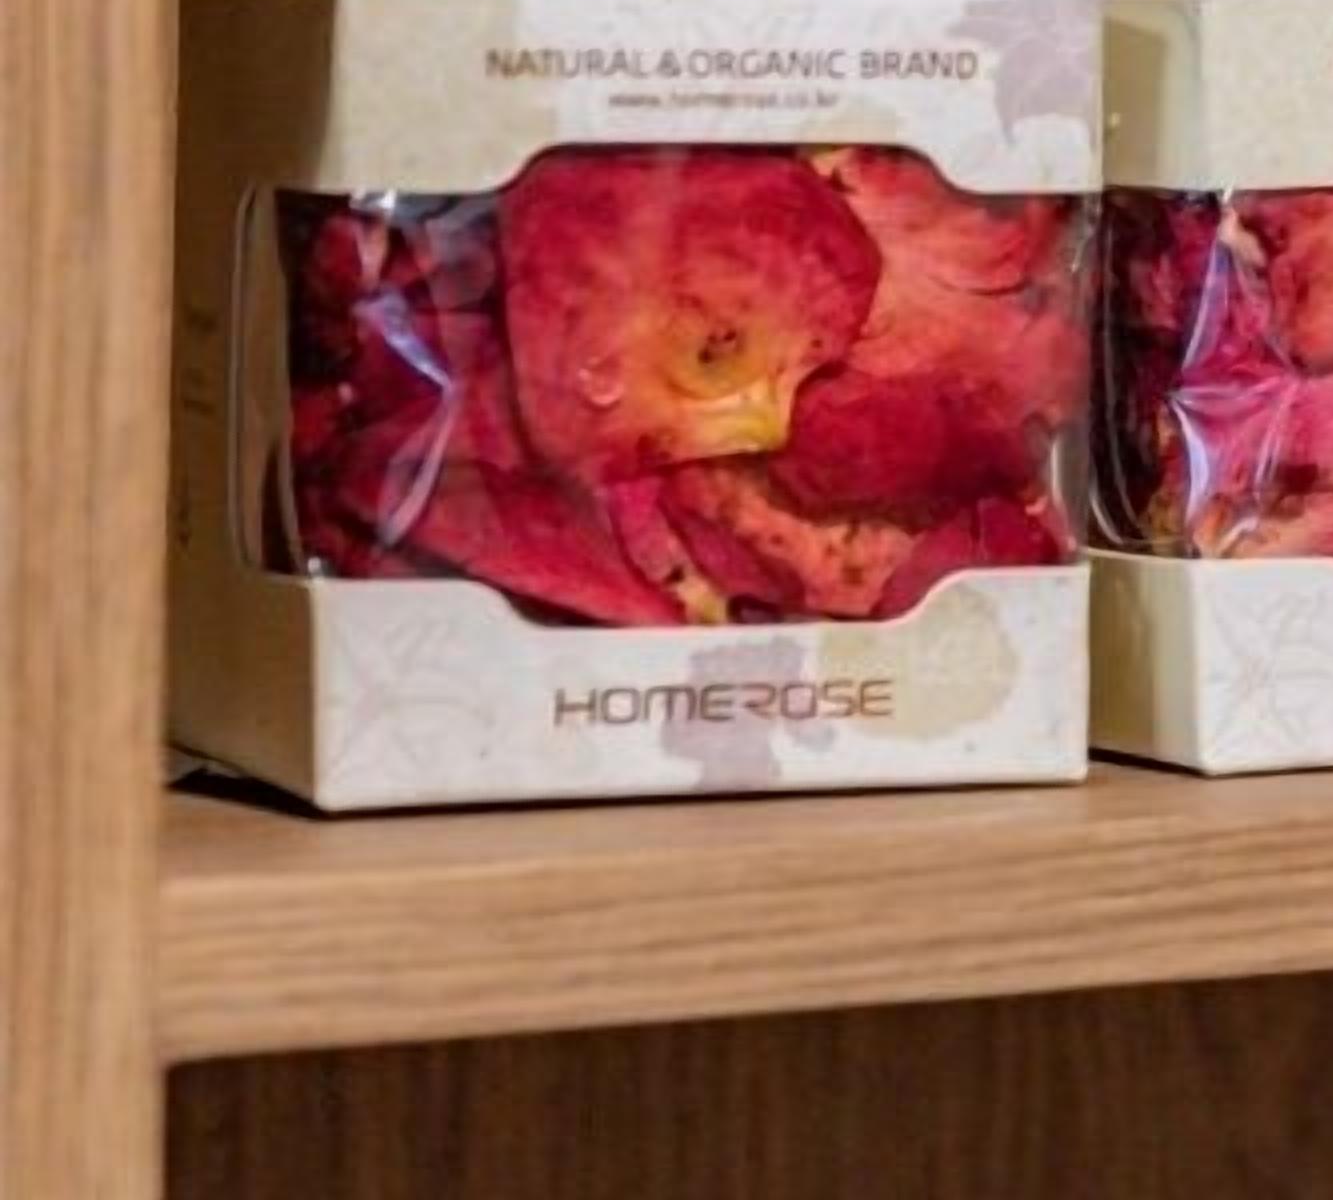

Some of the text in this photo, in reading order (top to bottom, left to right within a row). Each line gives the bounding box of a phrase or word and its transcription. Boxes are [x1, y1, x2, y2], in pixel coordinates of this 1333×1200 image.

[485, 49, 648, 80] NATURAL
[687, 48, 848, 80] ORGANIC
[860, 48, 980, 80] BRAND
[552, 678, 895, 727] HOMEROSE
